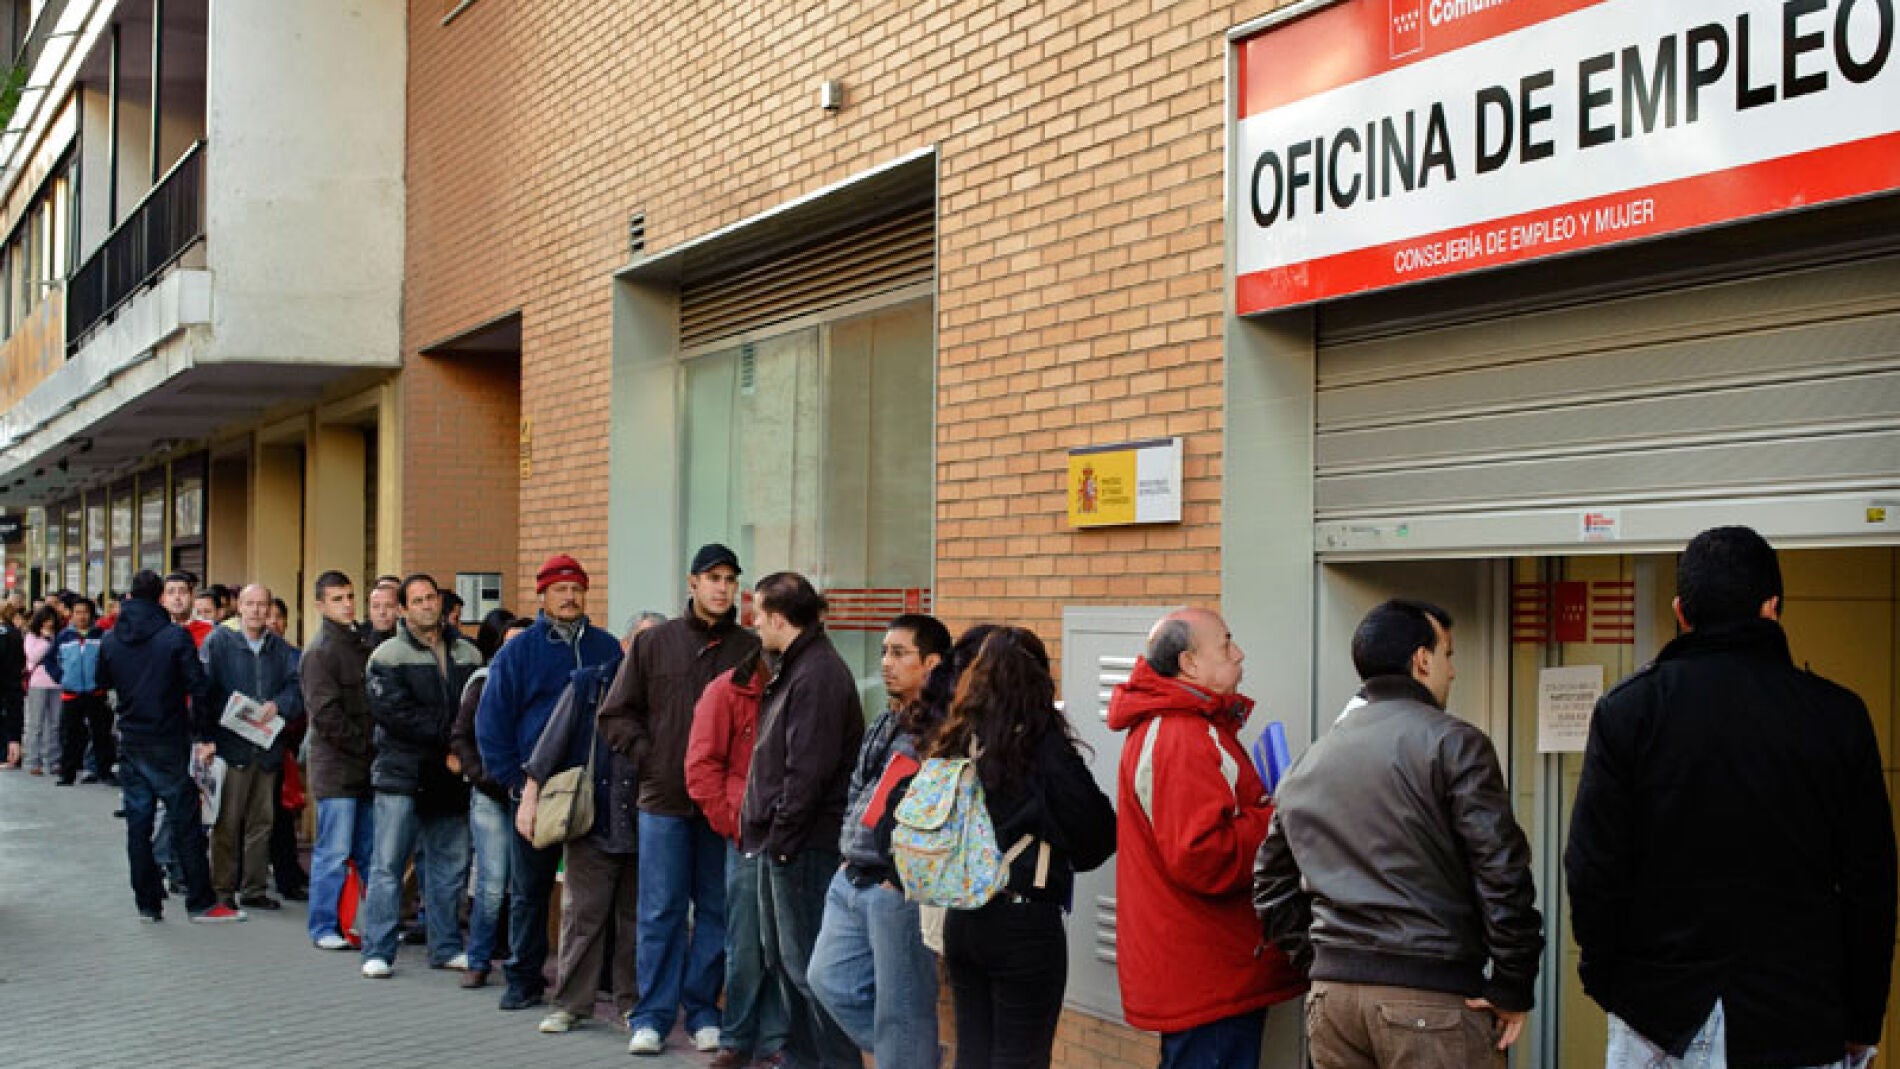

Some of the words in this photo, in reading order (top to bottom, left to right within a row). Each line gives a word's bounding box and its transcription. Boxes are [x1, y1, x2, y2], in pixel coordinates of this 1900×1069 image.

[1251, 101, 1457, 229] OFICINA
[1476, 70, 1554, 174] DE
[1578, 0, 1894, 149] EMPLEO
[1393, 230, 1483, 274] CONSEJERÍA
[1486, 229, 1507, 255] DE
[1510, 215, 1576, 251] EMPLEO
[1579, 211, 1592, 236] Y
[1595, 198, 1655, 234] MUJER
